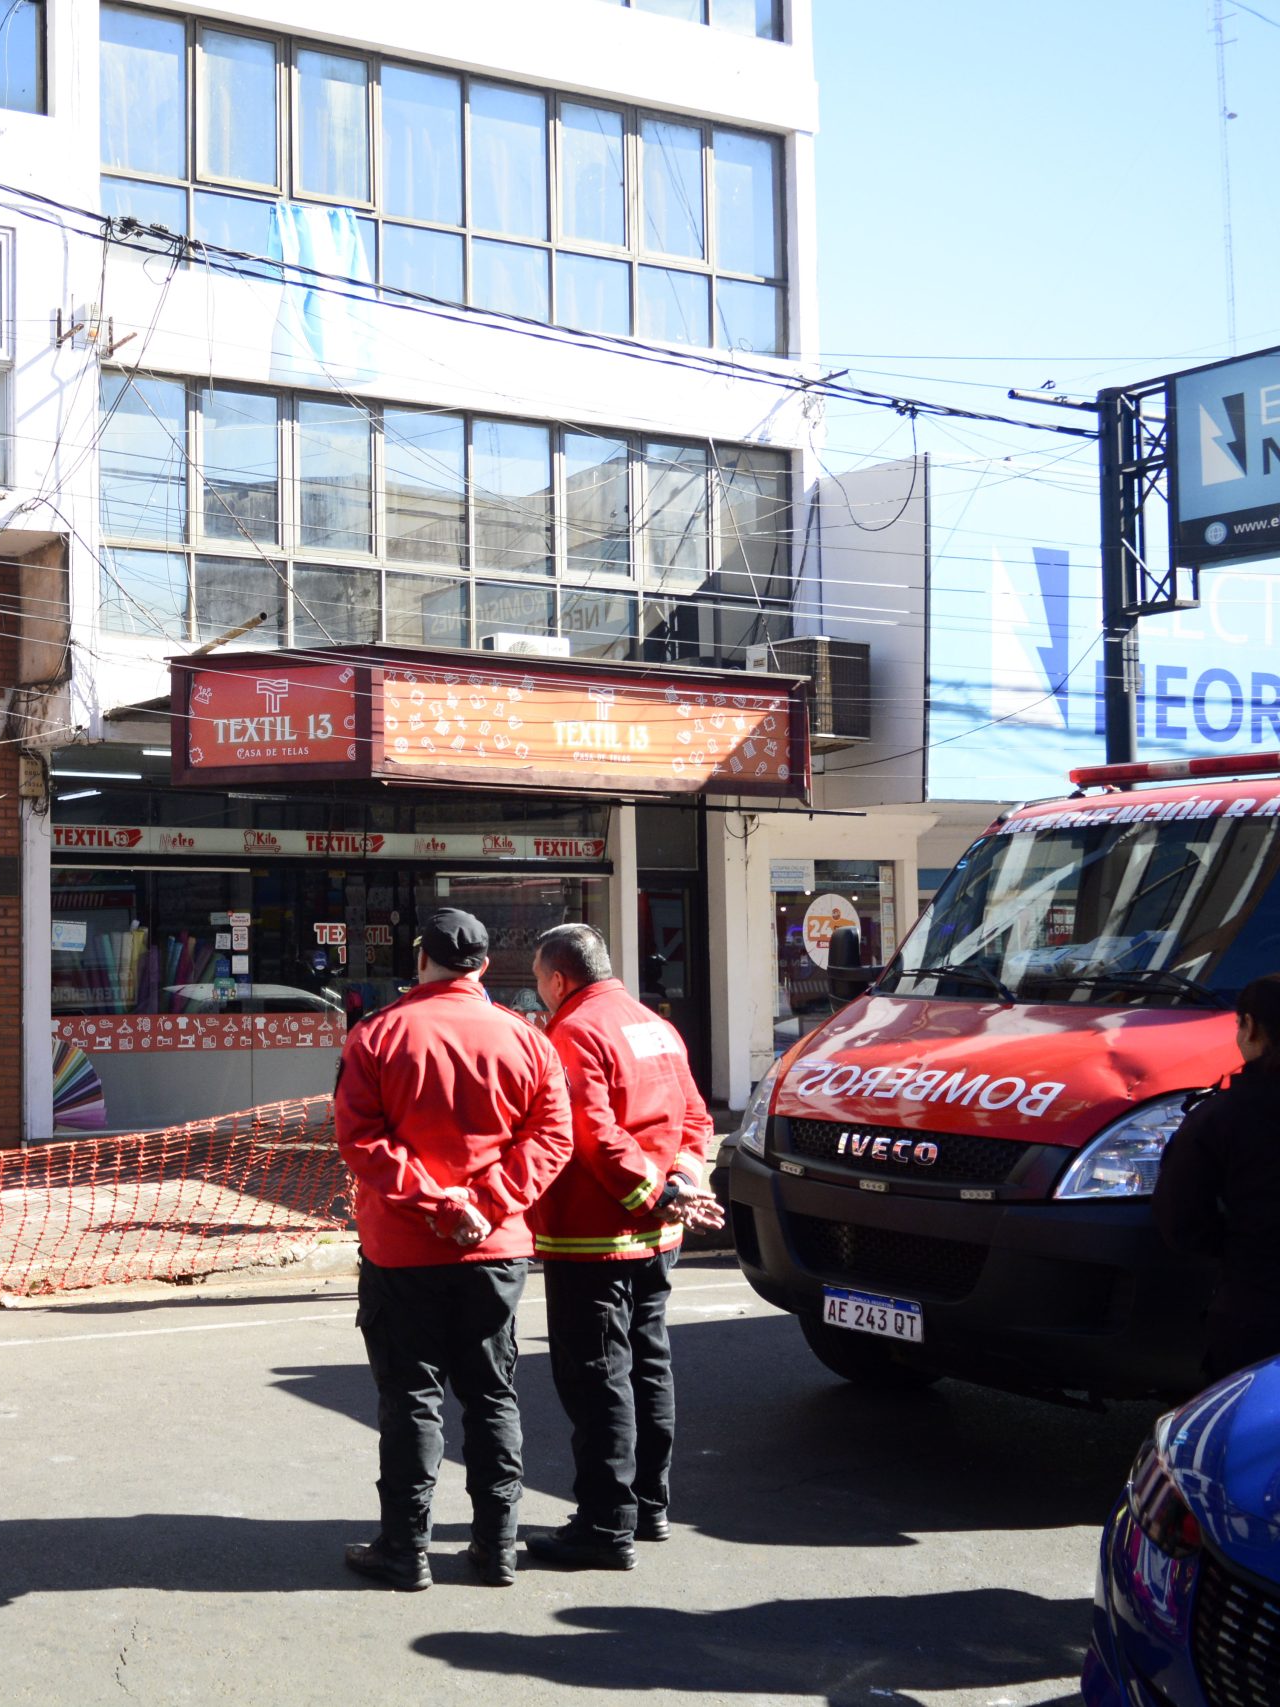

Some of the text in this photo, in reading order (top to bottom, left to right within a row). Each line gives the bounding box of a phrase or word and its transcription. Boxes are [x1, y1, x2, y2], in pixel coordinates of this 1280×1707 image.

[213, 713, 333, 744] TEXTIL 13
[553, 720, 649, 749] TEXTIL 13
[237, 747, 309, 759] CASA DE TELAS
[53, 828, 113, 847] TEXTIL
[257, 830, 277, 845] Kilo
[306, 834, 359, 853] TEXTIL
[493, 834, 513, 849] Kilo
[534, 839, 582, 857] TEXTIL
[234, 933, 241, 942] 3
[809, 919, 833, 938] 24
[837, 1132, 938, 1166] IVECO
[828, 1299, 917, 1338] AE 243 QT
